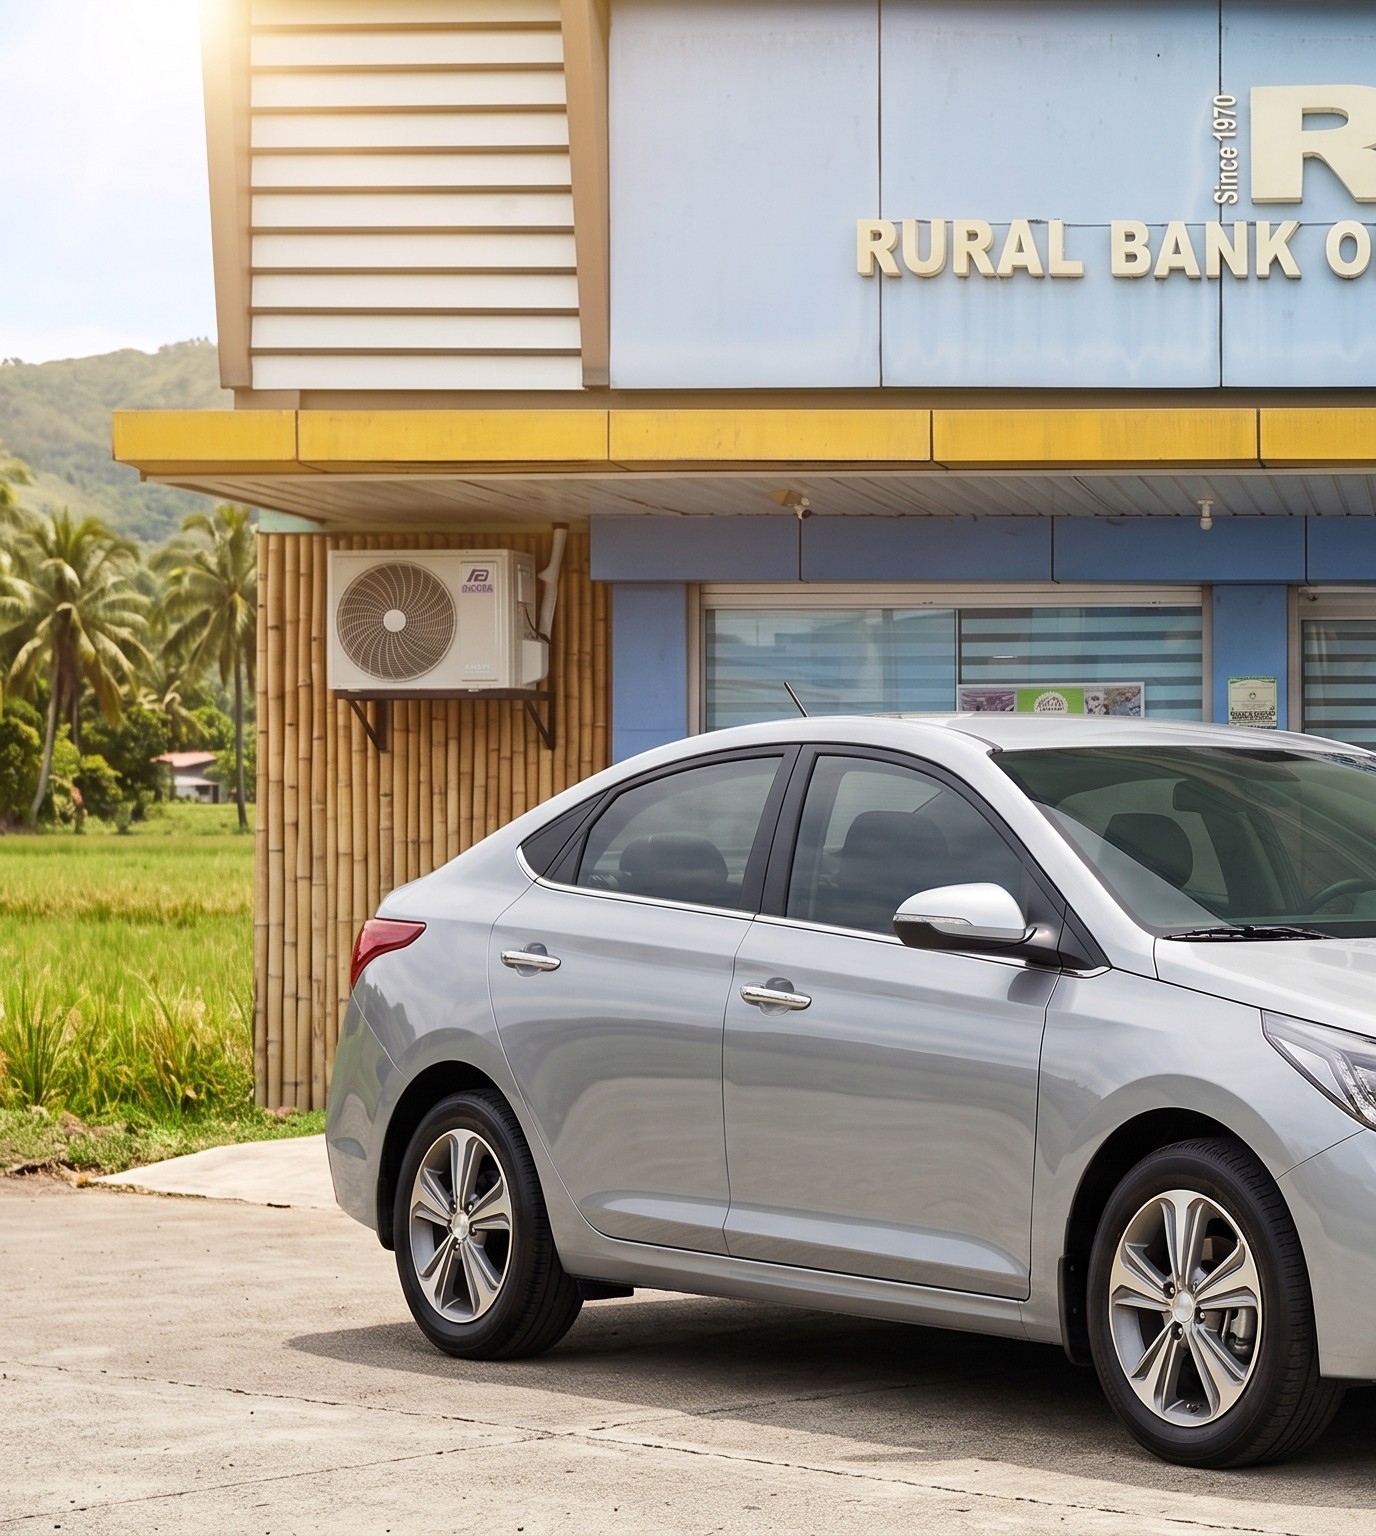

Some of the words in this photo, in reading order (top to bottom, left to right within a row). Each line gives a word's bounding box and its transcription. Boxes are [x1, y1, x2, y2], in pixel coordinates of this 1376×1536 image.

[1212, 95, 1237, 142] 1970
[1213, 147, 1238, 205] Since
[856, 218, 1084, 280] RURAL
[1111, 219, 1302, 281] BANK
